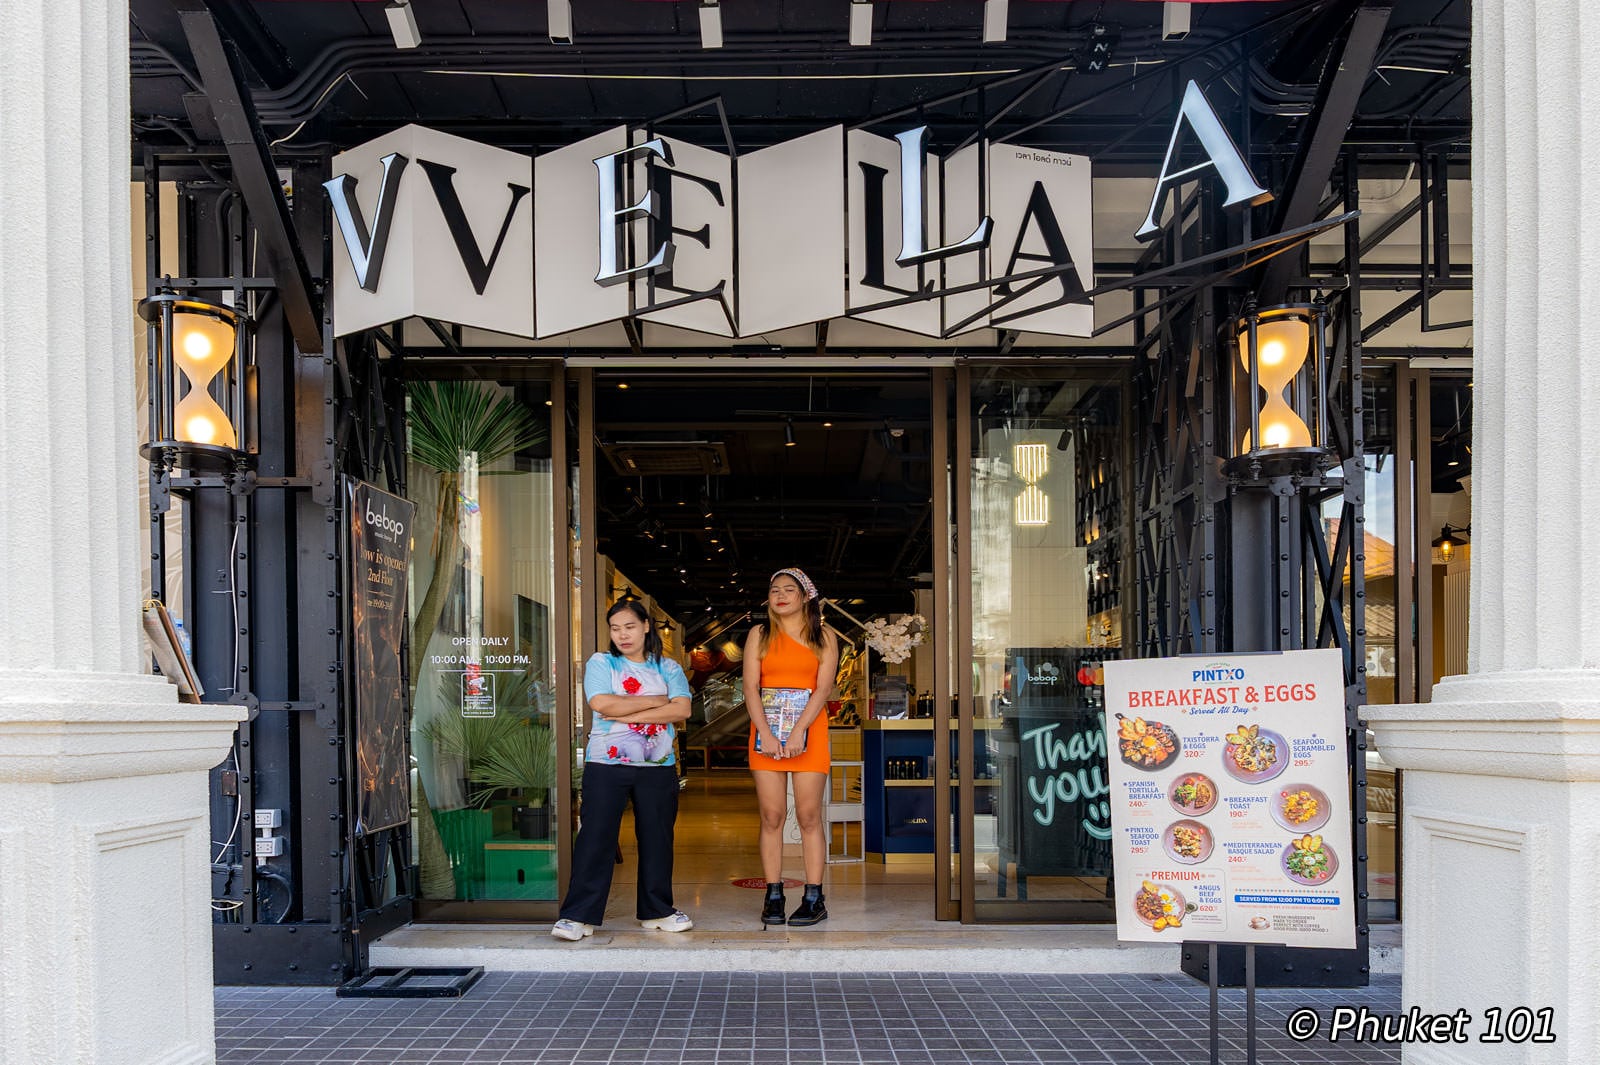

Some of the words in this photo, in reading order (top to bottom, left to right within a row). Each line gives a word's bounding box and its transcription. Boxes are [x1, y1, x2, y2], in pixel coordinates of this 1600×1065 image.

[366, 498, 404, 543] bebop
[367, 568, 381, 583] 2nd
[452, 637, 479, 646] OPEN
[481, 637, 509, 646] DAILY
[431, 655, 457, 664] 10:00
[485, 655, 511, 664] 10:00
[513, 655, 531, 664] PM.
[1192, 668, 1245, 683] PINTXO
[1128, 687, 1240, 708] BREAKFAST
[1244, 685, 1259, 704] &
[1264, 683, 1317, 703] EGGS
[1189, 706, 1215, 716] Served
[1217, 705, 1230, 715] All
[1231, 706, 1249, 716] Day
[1183, 736, 1220, 744] TXISTORRA
[1027, 765, 1110, 826] you
[1151, 871, 1200, 880] PREMIUM
